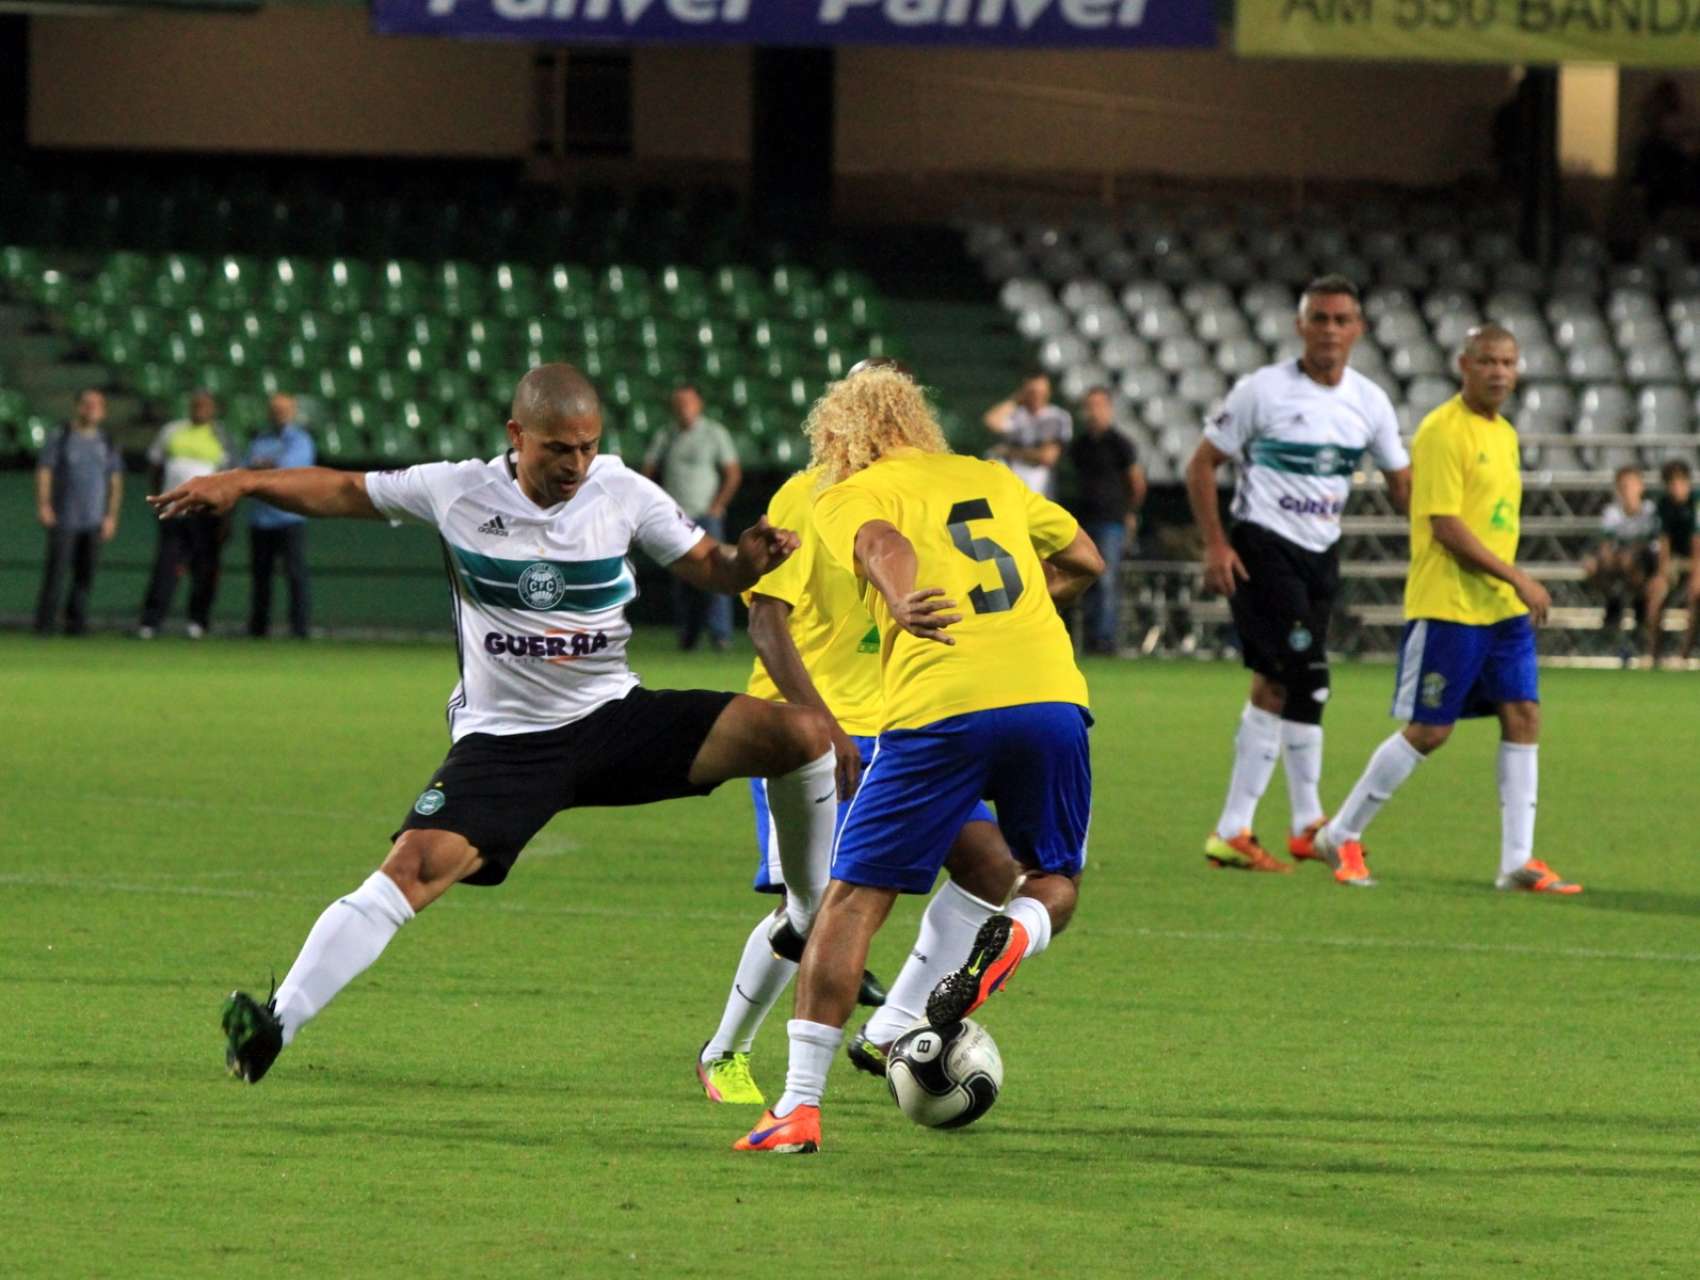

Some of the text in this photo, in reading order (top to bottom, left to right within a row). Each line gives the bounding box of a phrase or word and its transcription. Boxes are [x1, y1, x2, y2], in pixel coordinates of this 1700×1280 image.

[1516, 0, 1700, 35] BAND
[946, 497, 1024, 614] 5
[484, 630, 608, 657] GUERRA
